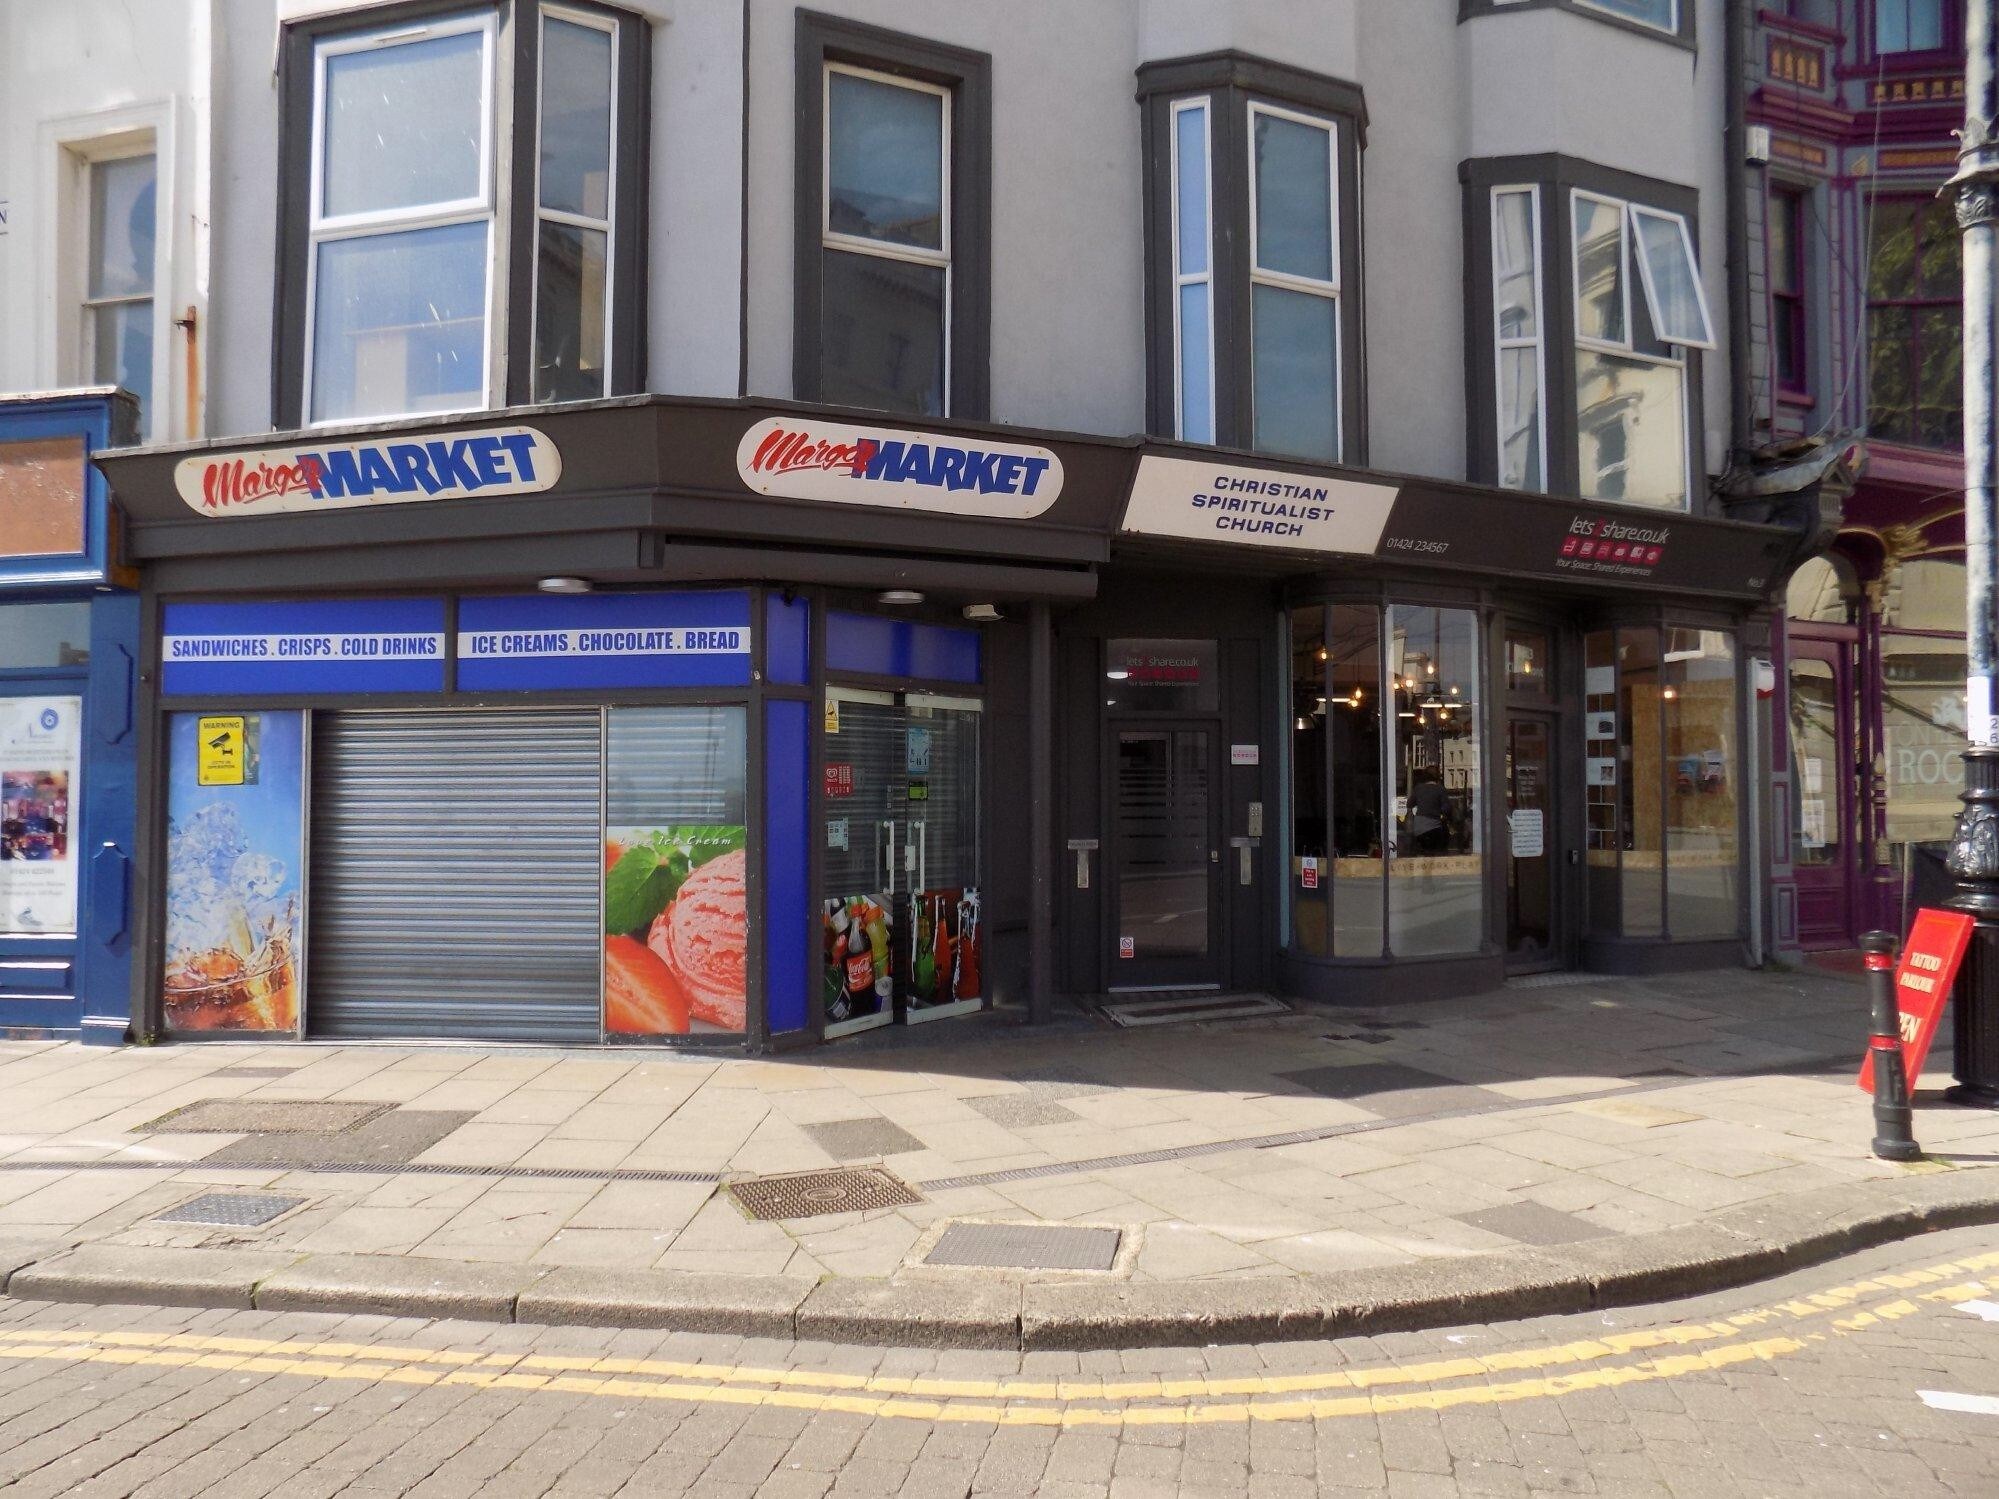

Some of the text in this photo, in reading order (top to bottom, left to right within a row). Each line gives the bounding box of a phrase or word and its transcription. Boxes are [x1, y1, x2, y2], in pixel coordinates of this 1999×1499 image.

[296, 433, 537, 500] MARKET
[850, 437, 1049, 495] MARKET
[1214, 476, 1328, 502] CHRISTIAN
[1191, 494, 1335, 521] SPIRITUALIST
[1215, 516, 1304, 537] CHURCH
[1386, 536, 1449, 554] 01424 234567
[172, 637, 437, 657] SANDWICHES CRISPS COLD DRINKS
[471, 631, 740, 654] ICE CREAMS CHOCOLATE BREAD
[1126, 656, 1199, 667] letsshare.co.uk
[687, 835, 731, 846] Cream
[1909, 951, 1942, 972] TATTOO
